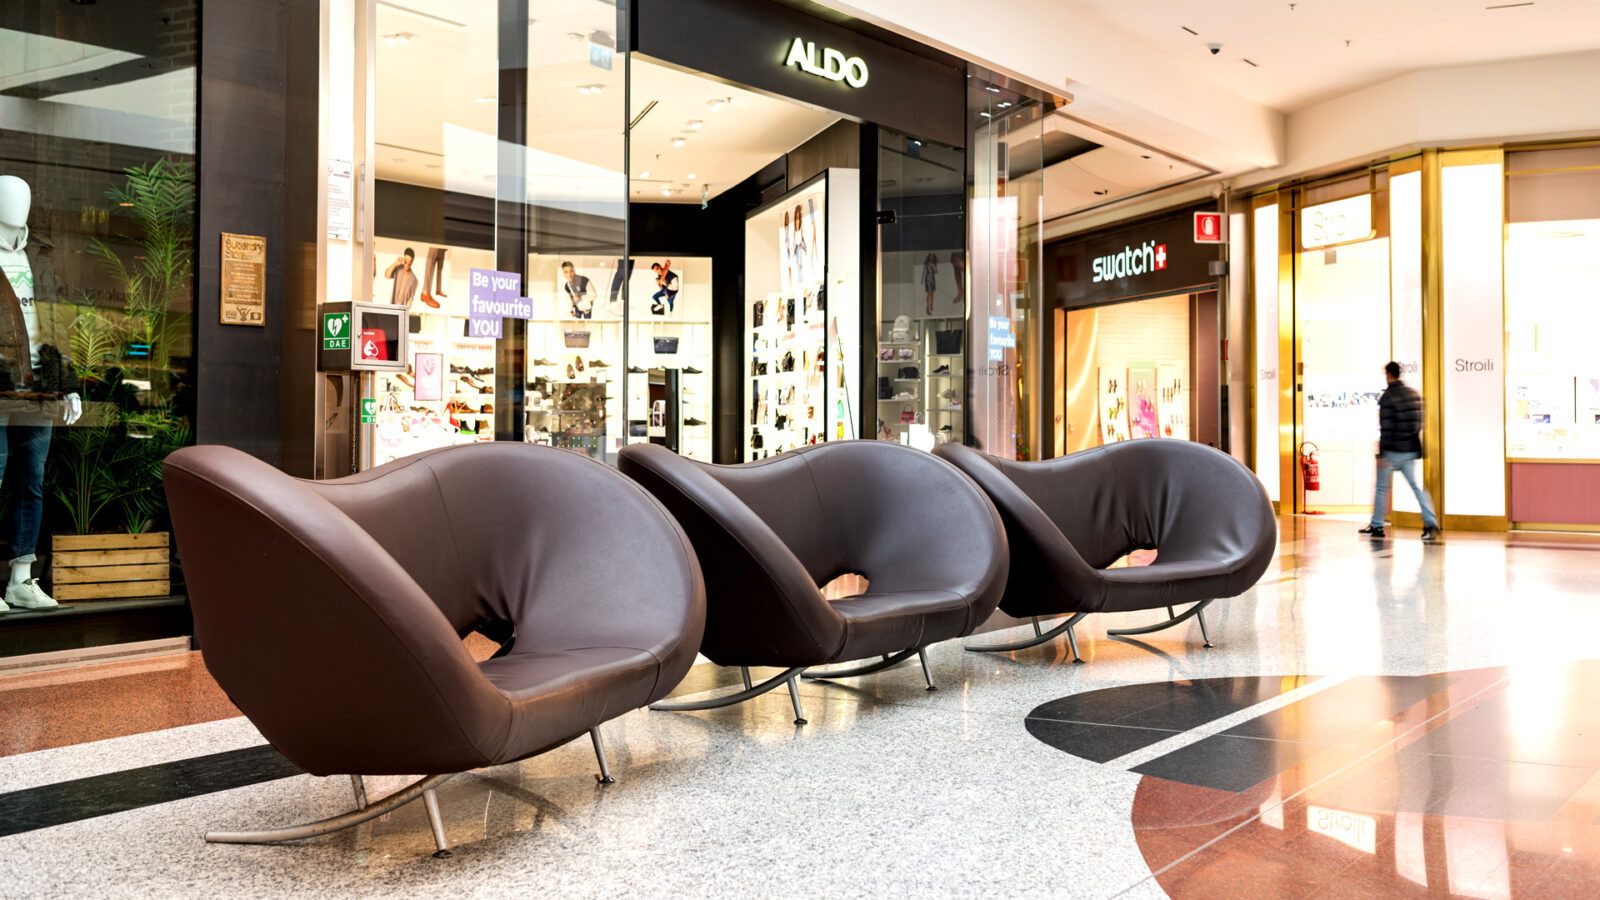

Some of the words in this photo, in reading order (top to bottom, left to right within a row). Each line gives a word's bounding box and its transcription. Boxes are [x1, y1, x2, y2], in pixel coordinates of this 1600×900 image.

[785, 36, 869, 88] ALDO
[1092, 240, 1156, 283] swatch
[472, 271, 489, 288] Be
[491, 275, 518, 292] your
[472, 294, 531, 317] favourite
[471, 318, 499, 337] YOU
[329, 339, 346, 348] DAE
[1455, 358, 1494, 372] Stroili
